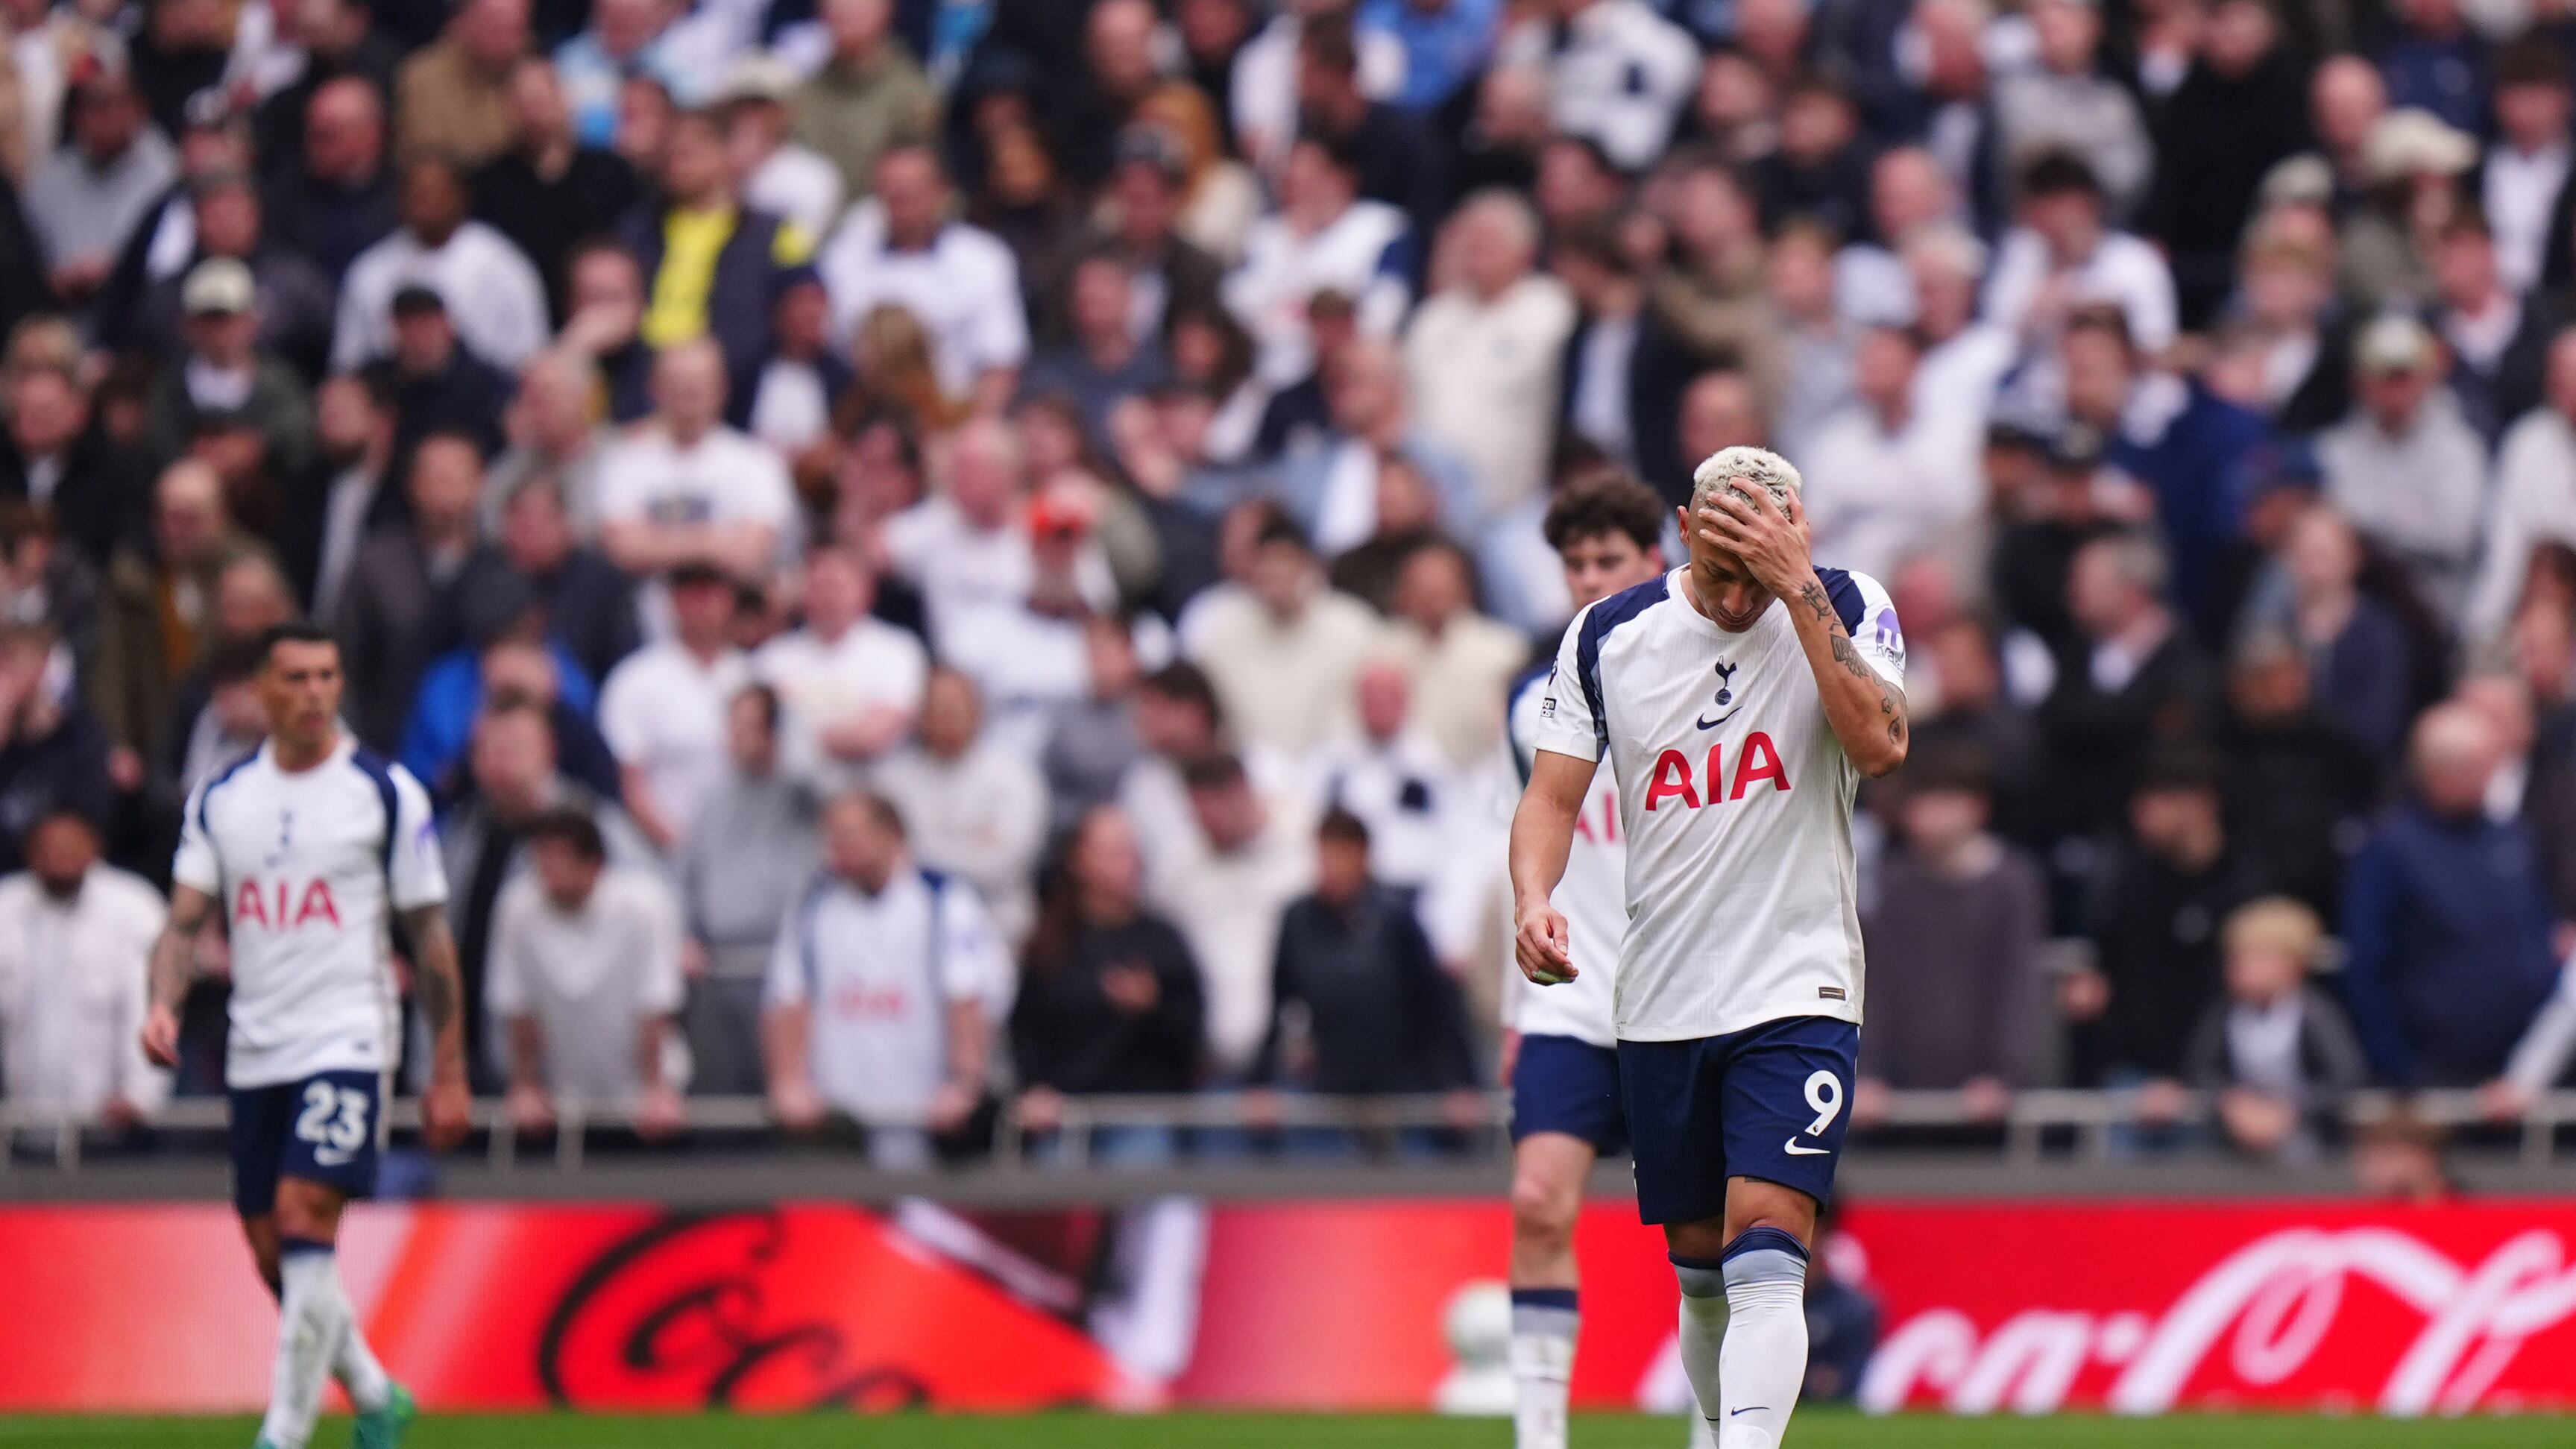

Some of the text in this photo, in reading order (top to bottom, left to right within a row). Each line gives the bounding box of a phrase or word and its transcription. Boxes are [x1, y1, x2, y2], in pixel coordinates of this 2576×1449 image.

[1646, 732, 1792, 811] AIA
[235, 877, 341, 928] AIA
[295, 1078, 369, 1167] 23
[1804, 1069, 1843, 1137] 9
